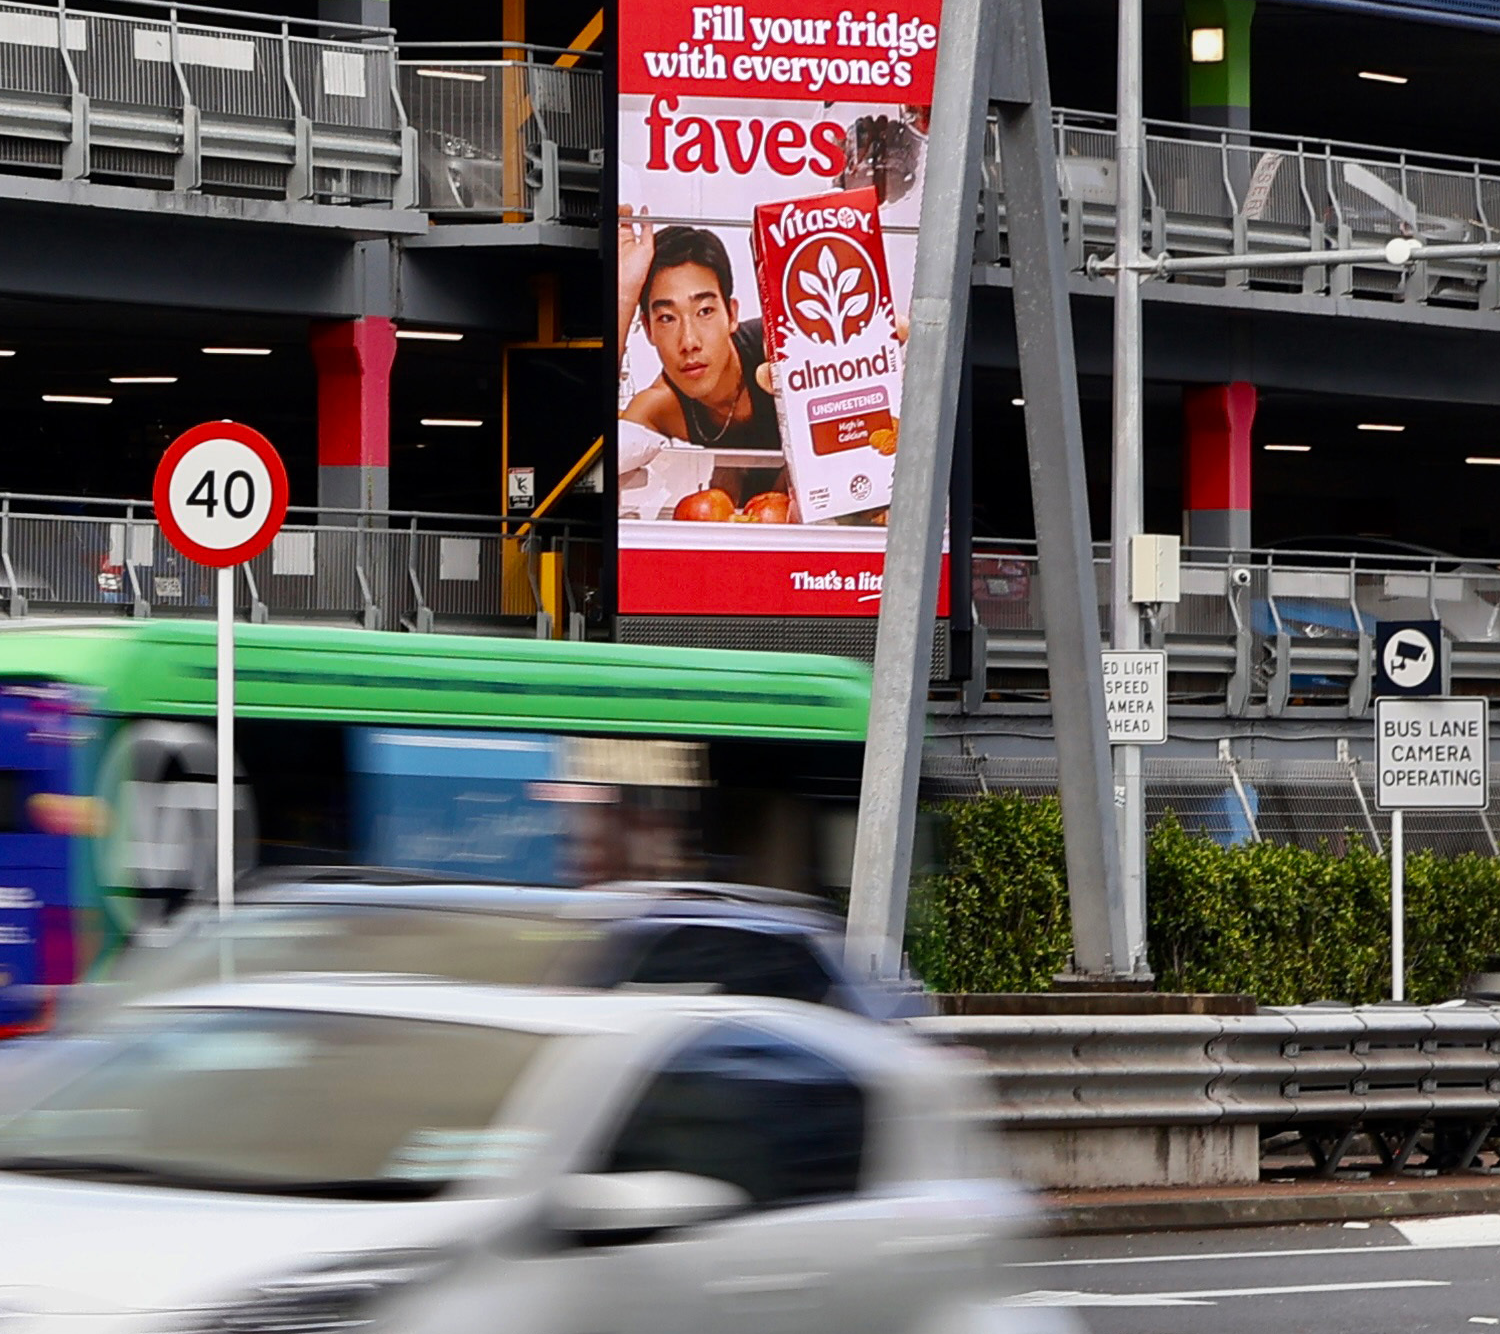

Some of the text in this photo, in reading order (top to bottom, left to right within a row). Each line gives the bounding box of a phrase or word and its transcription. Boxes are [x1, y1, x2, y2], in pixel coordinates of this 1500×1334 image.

[691, 4, 937, 57] Fill your fridge
[643, 41, 912, 91] with everyone's
[644, 90, 848, 178] faves
[788, 345, 890, 392] almond
[888, 347, 898, 373] MILK
[811, 392, 885, 416] UNSWEETENED
[184, 469, 256, 520] 40
[790, 569, 883, 591] That's a litt
[1103, 661, 1160, 675] ED LIGHT
[1105, 680, 1149, 694] SPEED
[1107, 700, 1155, 713] AMERA
[1107, 719, 1150, 733] AHEAD
[1384, 720, 1479, 737] BUS LANE
[1391, 744, 1472, 762] CAMERA
[1382, 769, 1482, 786] OPERATING
